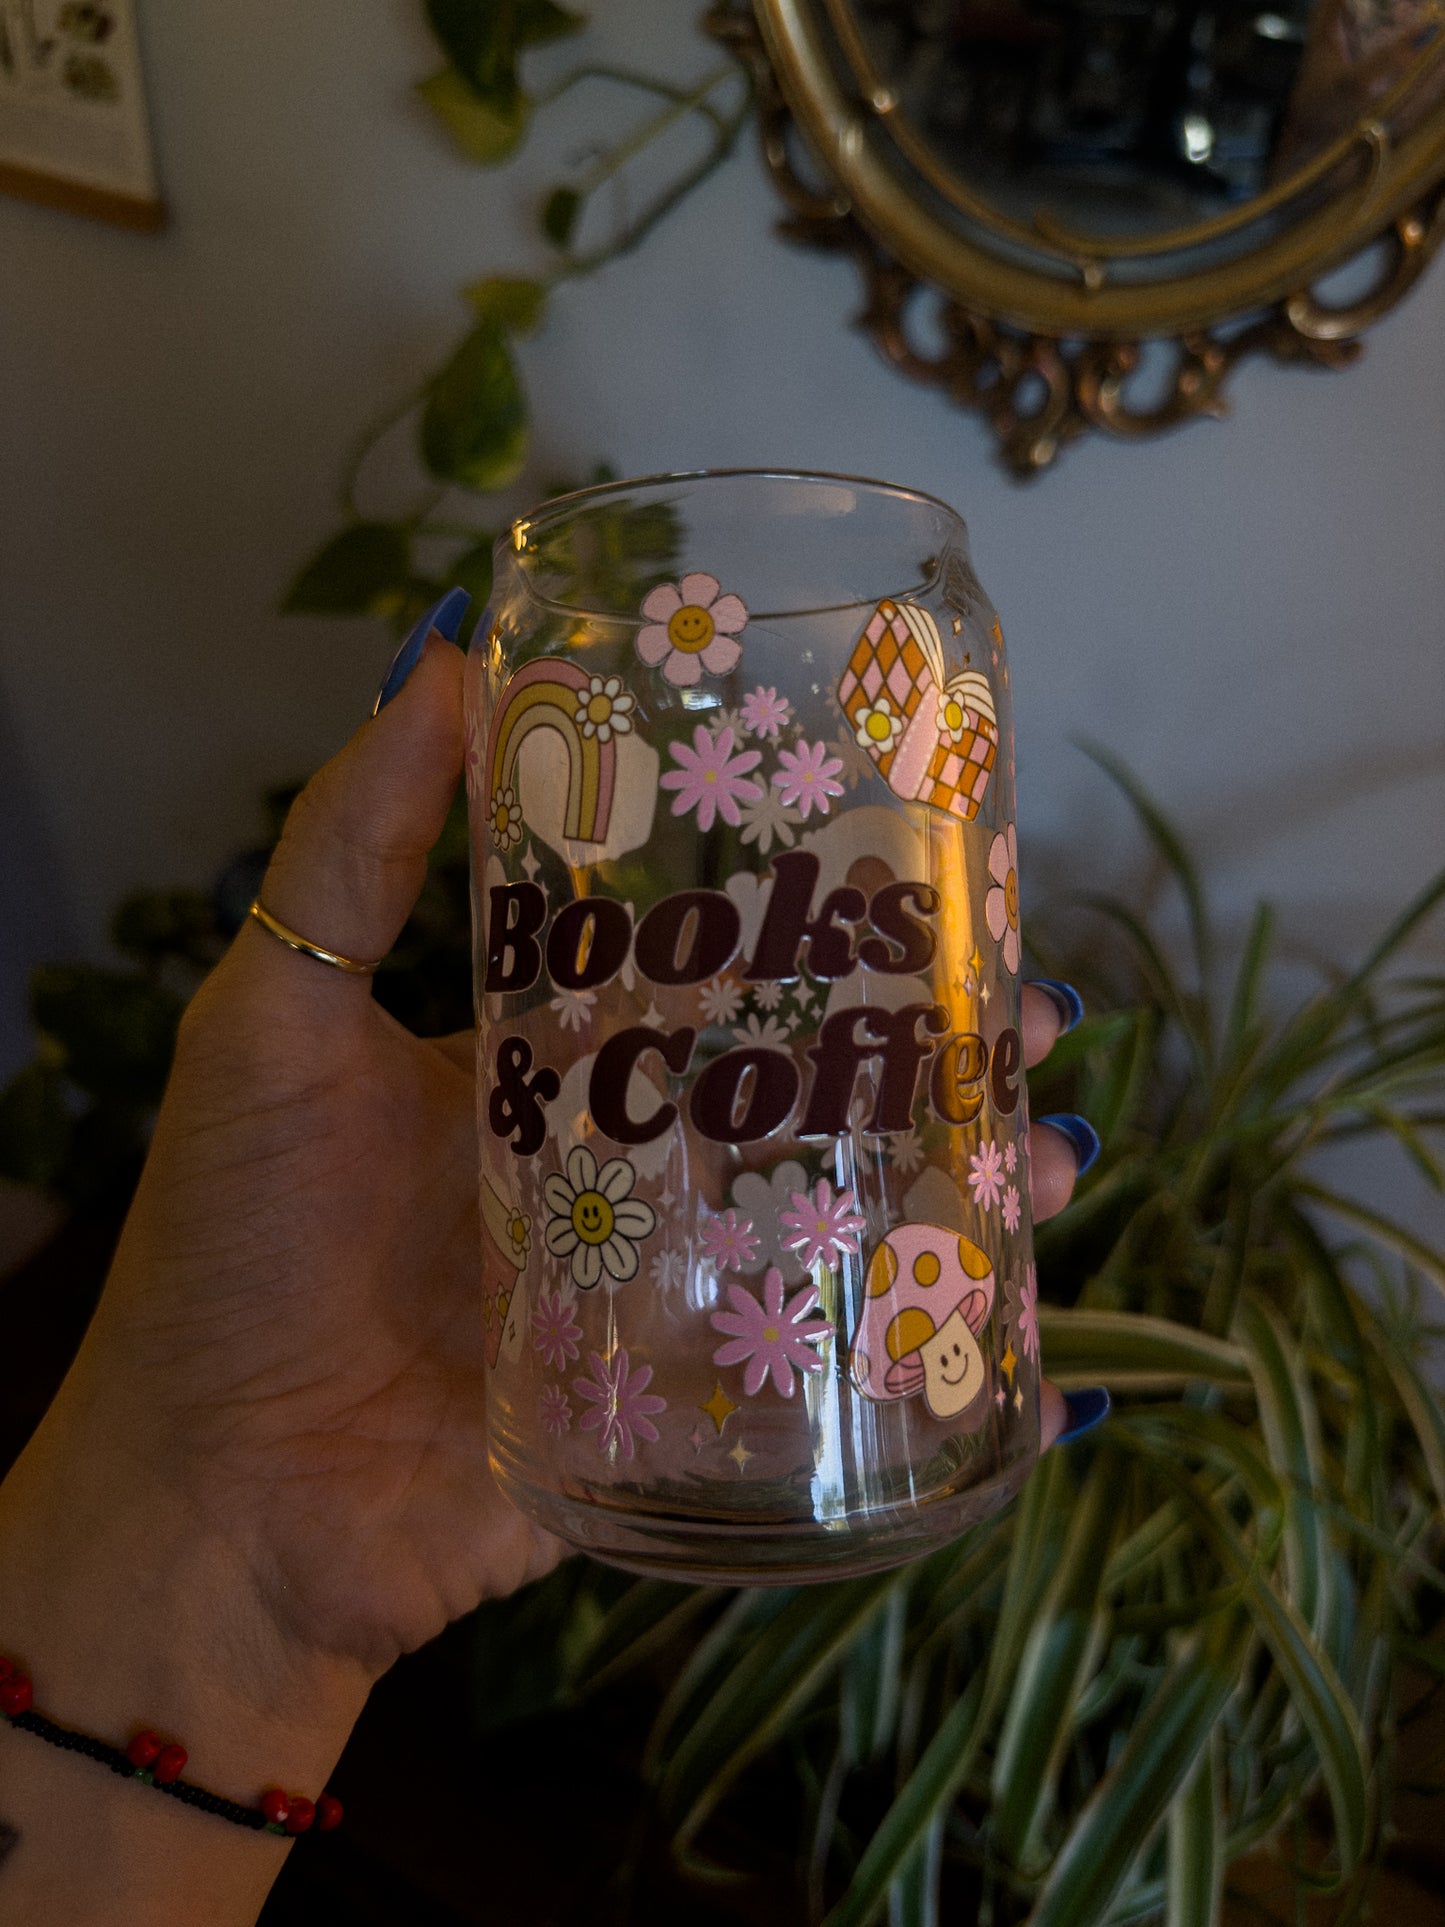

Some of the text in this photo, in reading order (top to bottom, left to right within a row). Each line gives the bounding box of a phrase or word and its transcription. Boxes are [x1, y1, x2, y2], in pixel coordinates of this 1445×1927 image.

[485, 850, 942, 994] Books
[488, 1003, 1021, 1157] & Coffee
